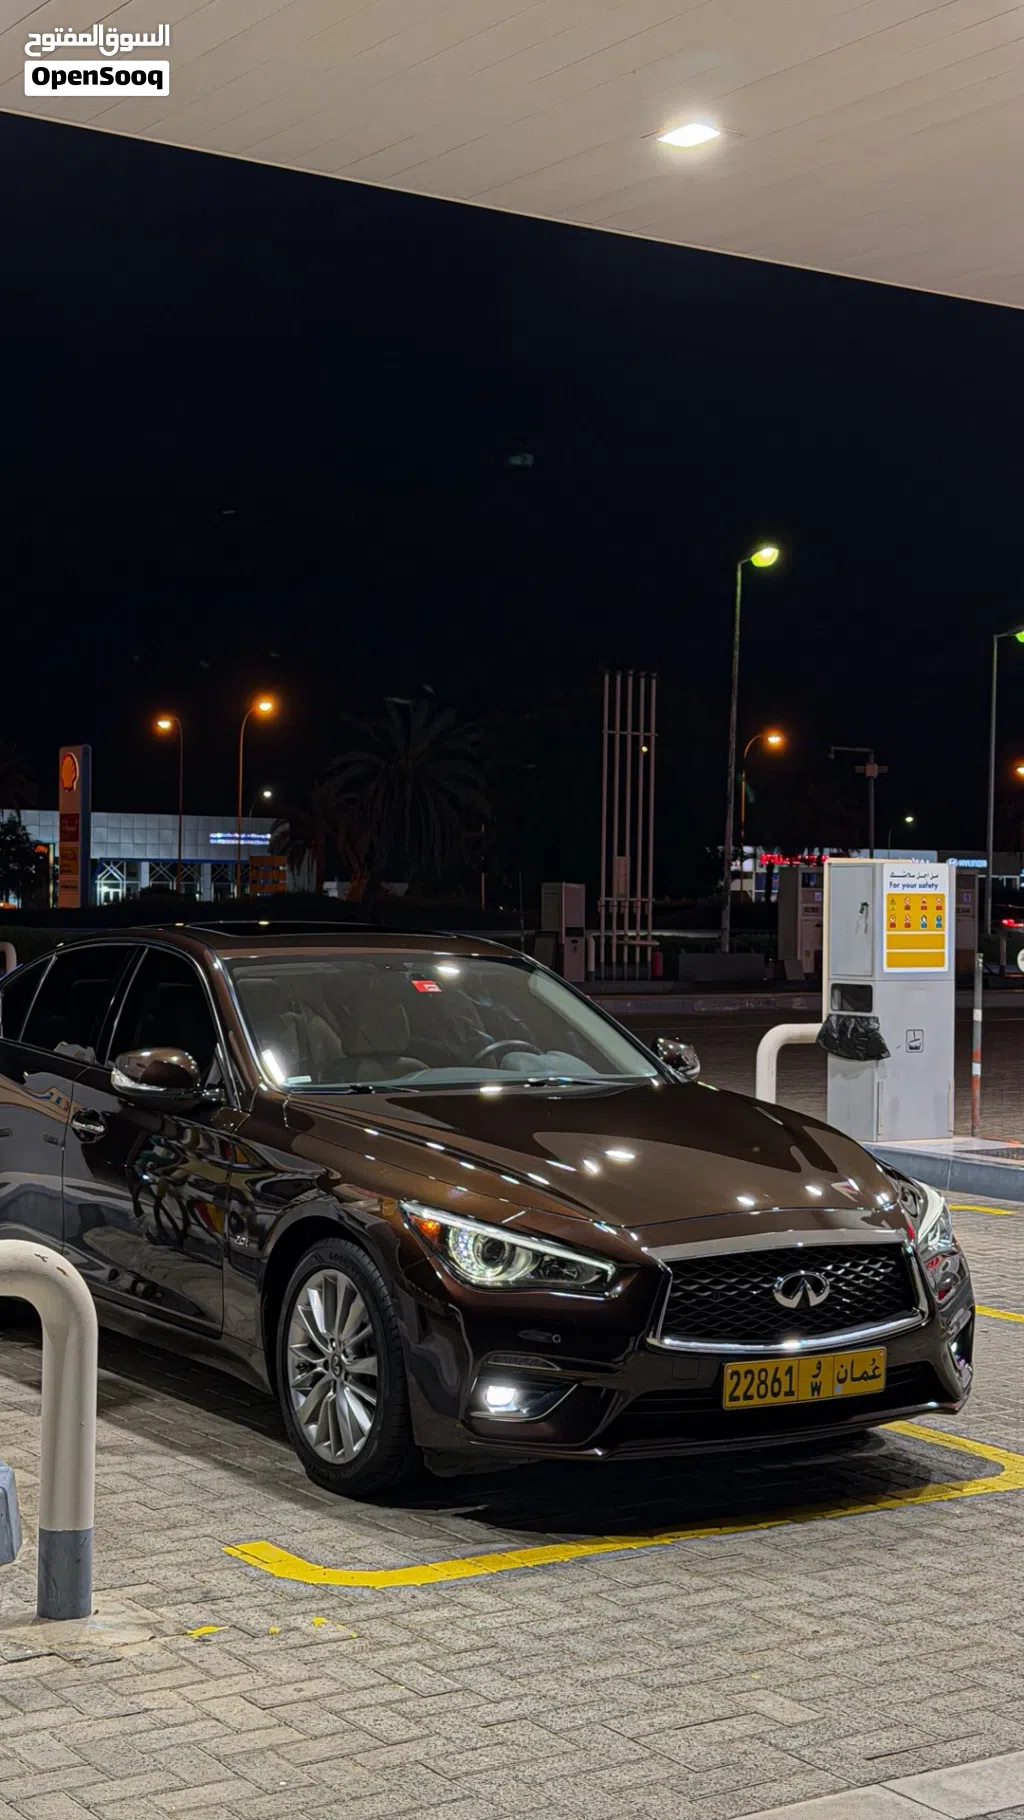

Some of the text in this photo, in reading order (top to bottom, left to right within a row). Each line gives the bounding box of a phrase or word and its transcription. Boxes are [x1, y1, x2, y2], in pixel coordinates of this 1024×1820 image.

[889, 880, 939, 891] For your safety
[728, 1365, 796, 1403] 22861
[810, 1380, 822, 1398] W
